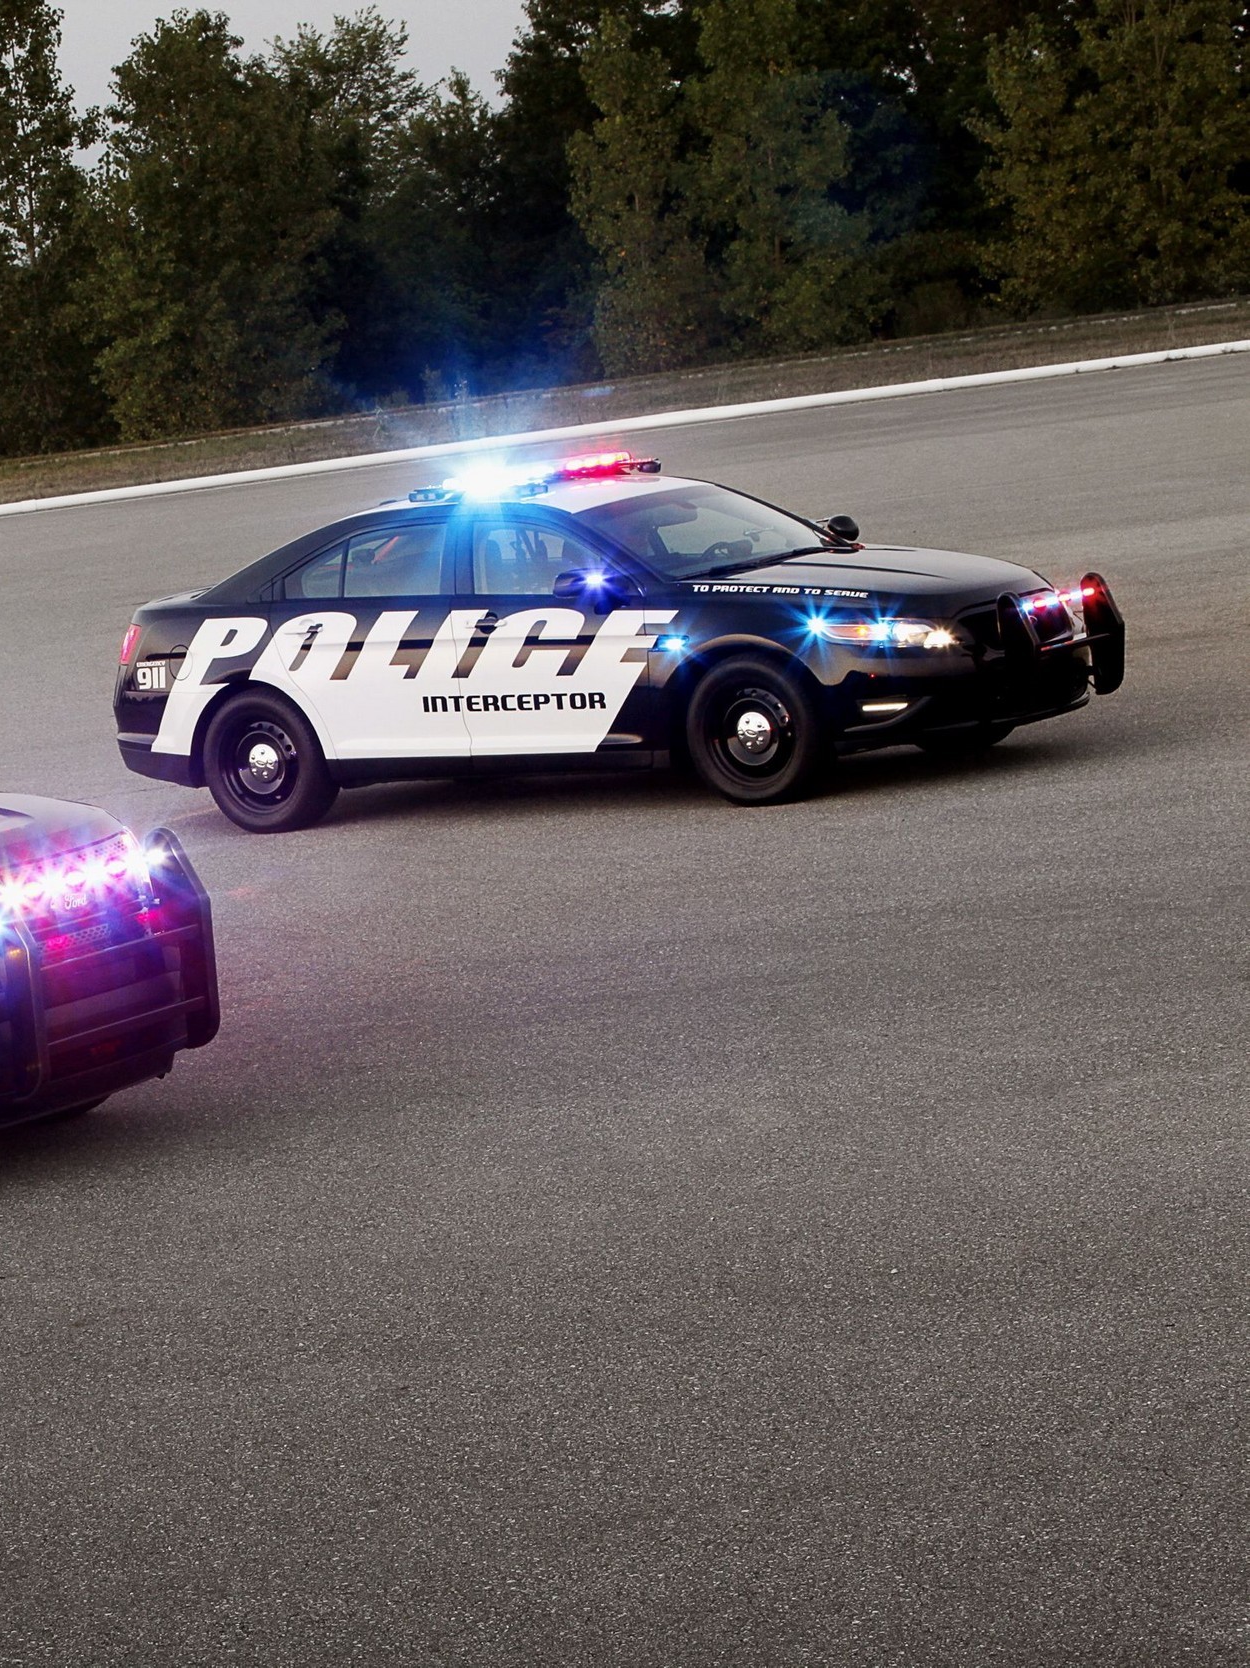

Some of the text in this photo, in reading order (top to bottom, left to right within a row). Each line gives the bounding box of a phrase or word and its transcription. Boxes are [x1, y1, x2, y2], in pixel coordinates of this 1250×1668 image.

[692, 584, 869, 599] TO PROTECT AND TO SERVE
[174, 608, 679, 687] POLICE
[136, 666, 166, 690] 911
[422, 692, 607, 713] INTERCEPTOR
